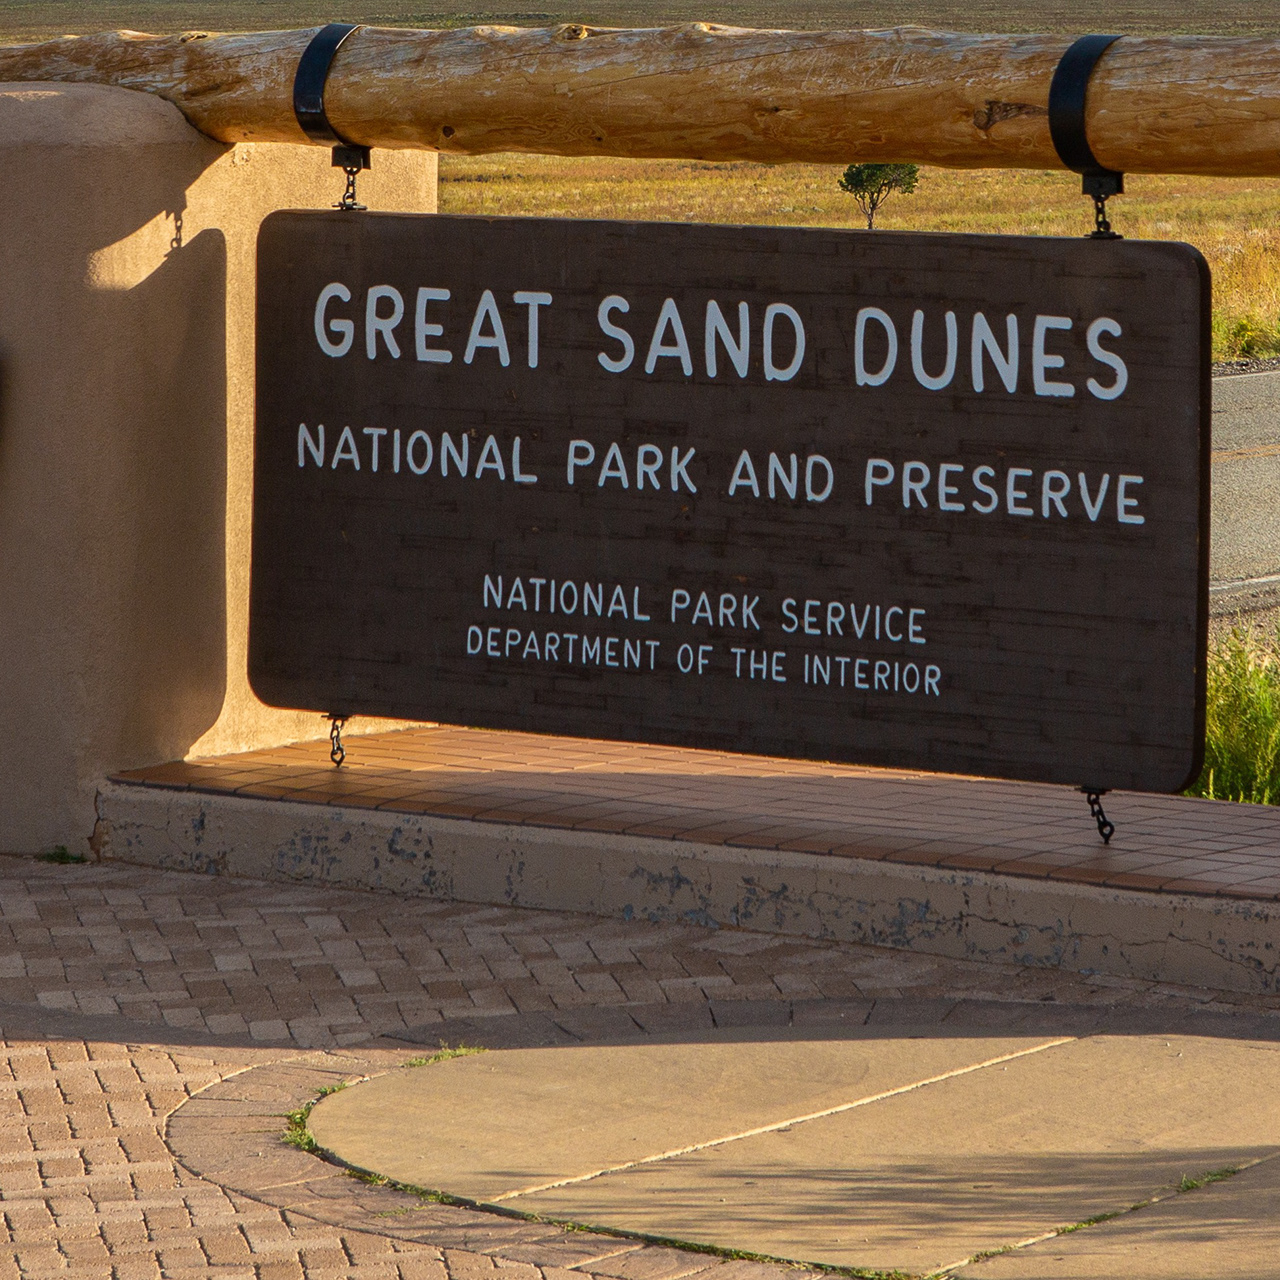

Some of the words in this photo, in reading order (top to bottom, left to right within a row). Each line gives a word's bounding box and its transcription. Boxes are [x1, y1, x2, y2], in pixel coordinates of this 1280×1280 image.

[314, 282, 552, 368] GREAT
[598, 295, 805, 381] SAND
[855, 307, 1128, 400] DUNES
[298, 423, 537, 483] NATIONAL
[567, 440, 697, 493] PARK
[729, 450, 833, 501] AND
[865, 459, 1145, 524] PRESERVE
[484, 575, 650, 620] NATIONAL
[671, 589, 760, 630] PARK
[782, 598, 926, 643] SERVICE
[467, 619, 660, 669] DEPARTMENT
[677, 644, 712, 674] OF
[731, 648, 786, 681] THE
[805, 654, 941, 696] INTERIOR
